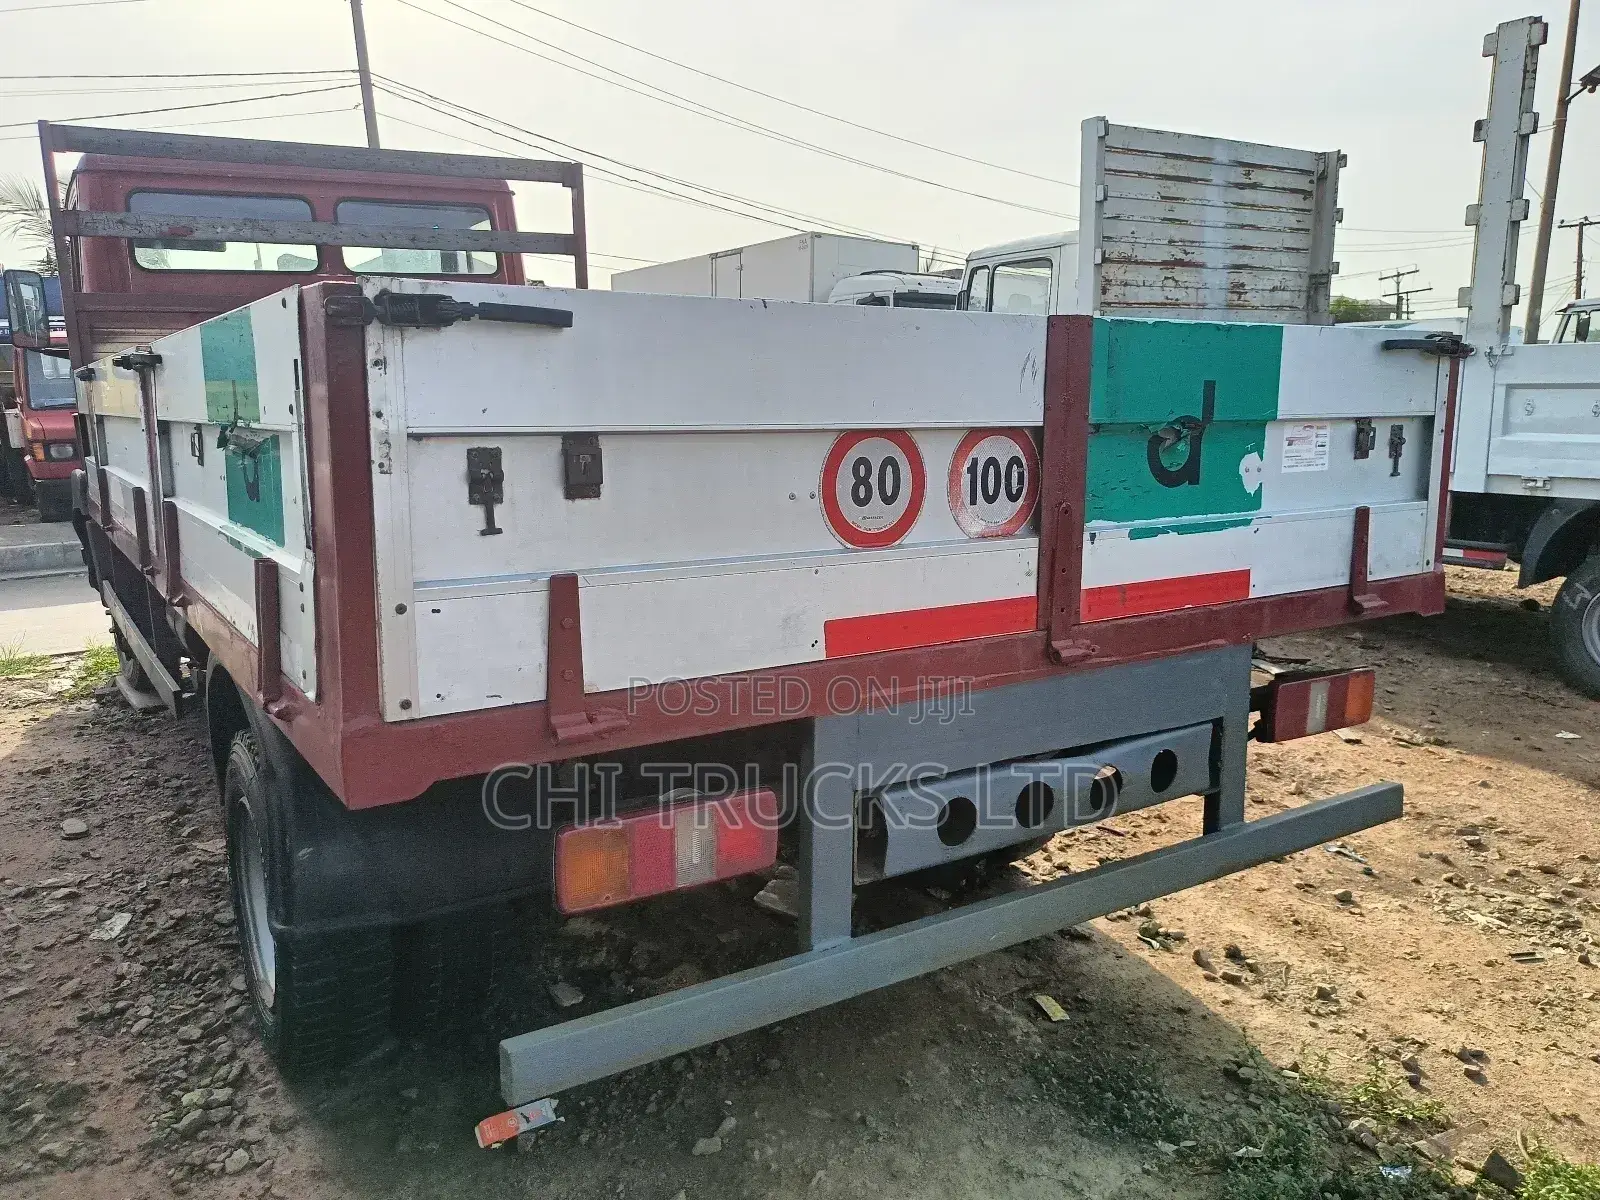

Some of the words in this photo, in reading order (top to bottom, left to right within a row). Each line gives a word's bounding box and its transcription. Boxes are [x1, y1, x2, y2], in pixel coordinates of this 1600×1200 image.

[1147, 380, 1216, 488] d
[851, 455, 900, 507] 80
[966, 455, 1025, 505] 100
